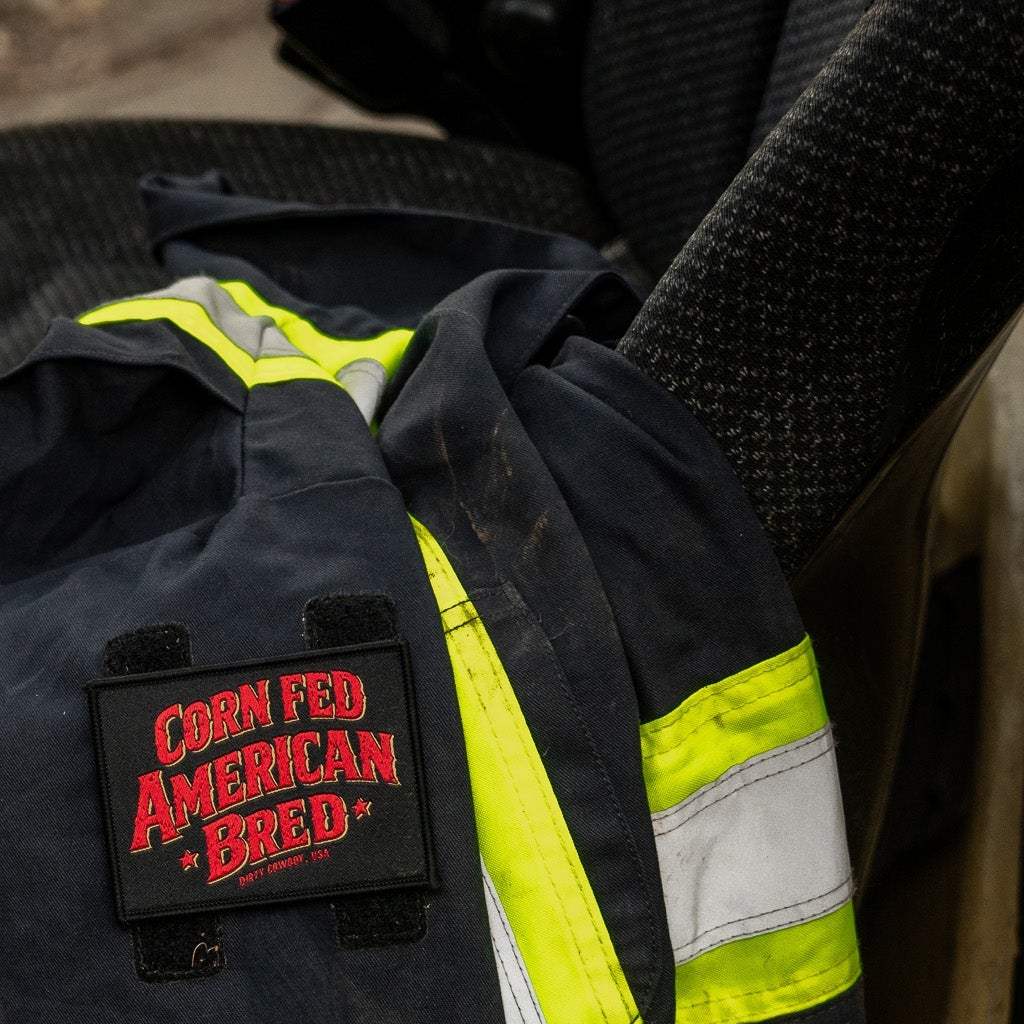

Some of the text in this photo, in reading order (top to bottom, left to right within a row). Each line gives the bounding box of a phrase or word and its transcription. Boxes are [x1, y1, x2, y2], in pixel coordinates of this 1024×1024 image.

[153, 669, 367, 767] CORN FED
[130, 729, 401, 853] AMERICAN
[202, 792, 350, 884] BRED
